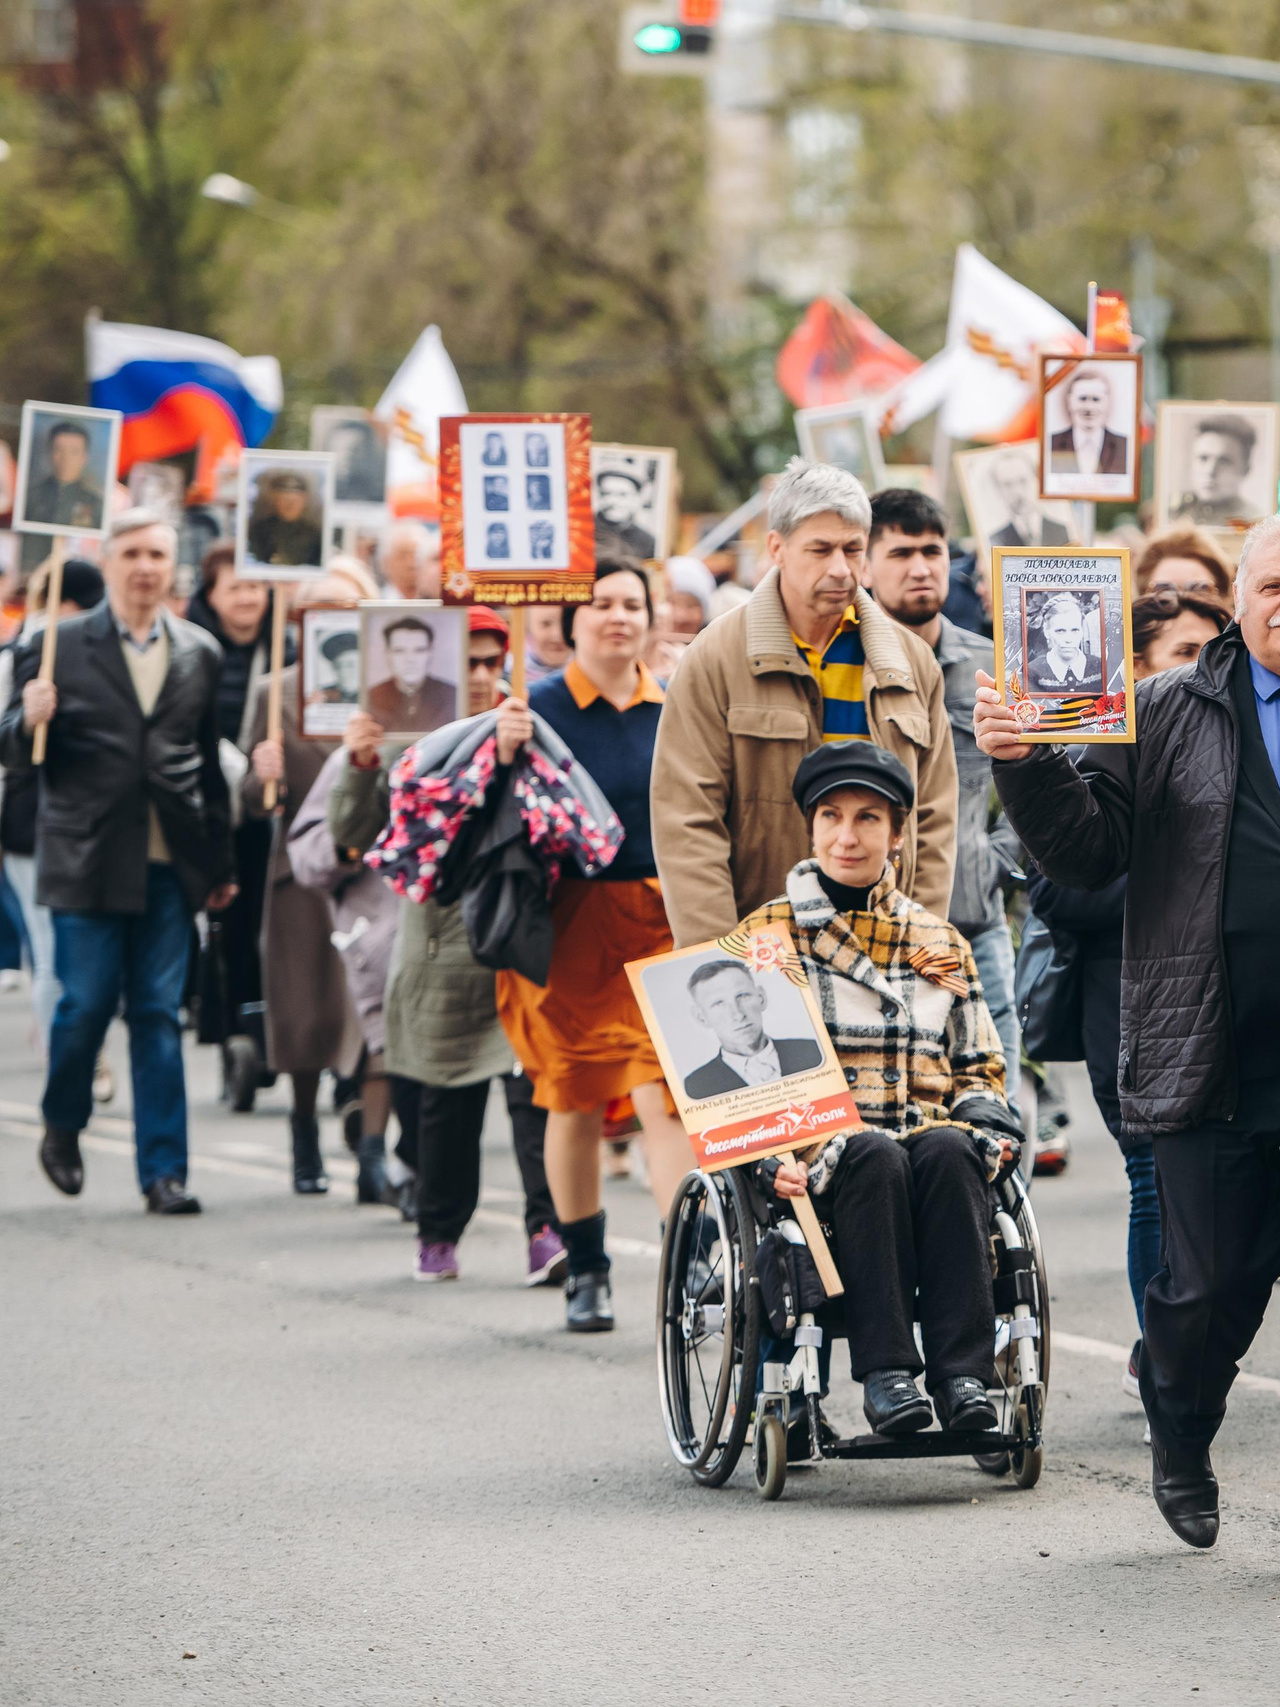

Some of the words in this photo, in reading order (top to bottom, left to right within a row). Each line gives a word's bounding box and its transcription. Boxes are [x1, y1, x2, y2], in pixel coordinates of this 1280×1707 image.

[1024, 558, 1097, 569] ТАНАНАЕВА
[1005, 573, 1037, 583] НИНА
[1040, 573, 1118, 584] НИКОЛАЕВНА
[683, 1096, 732, 1115] ИГНАТЬЕВ
[734, 1084, 782, 1102] Александр
[784, 1068, 837, 1088] Васильевич
